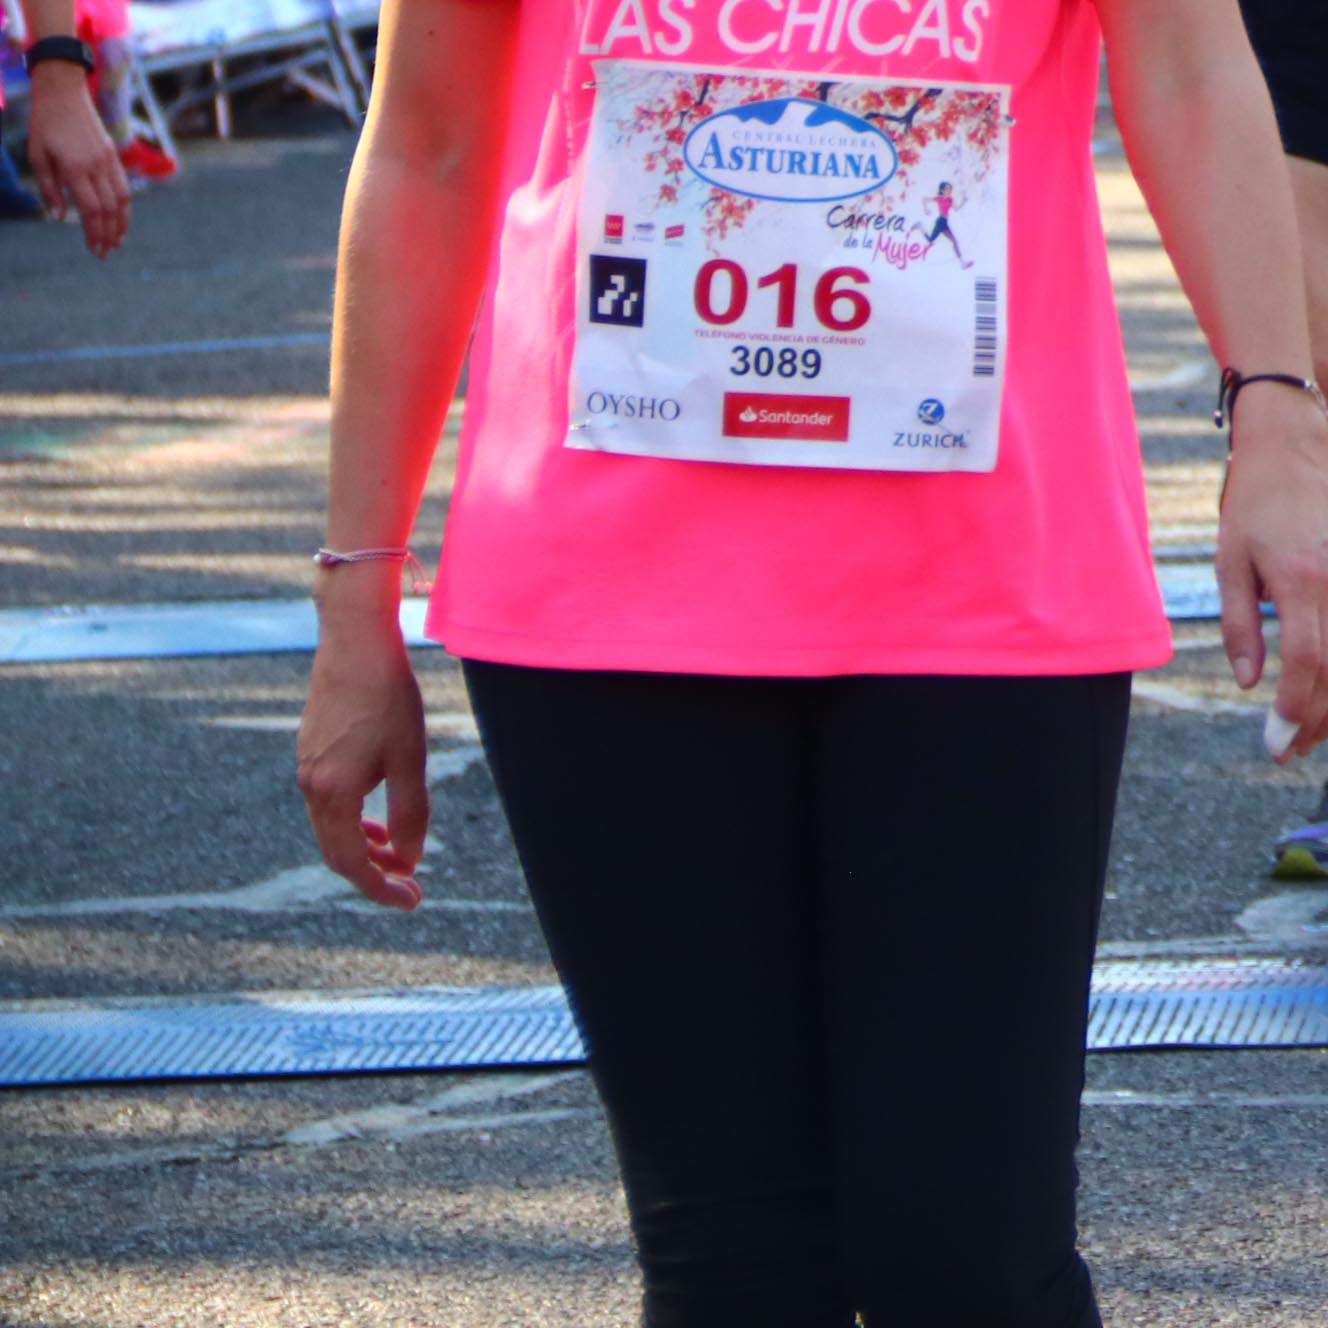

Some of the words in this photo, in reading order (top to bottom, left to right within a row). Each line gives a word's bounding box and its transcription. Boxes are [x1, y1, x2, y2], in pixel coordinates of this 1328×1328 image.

[699, 131, 881, 179] ASTURIANA
[826, 204, 906, 233] Carrera
[873, 234, 932, 270] Mujer
[693, 258, 872, 332] 016
[730, 345, 823, 379] 3089
[586, 391, 681, 422] OYSHO
[759, 408, 834, 426] Santander
[892, 432, 968, 449] ZURICH
